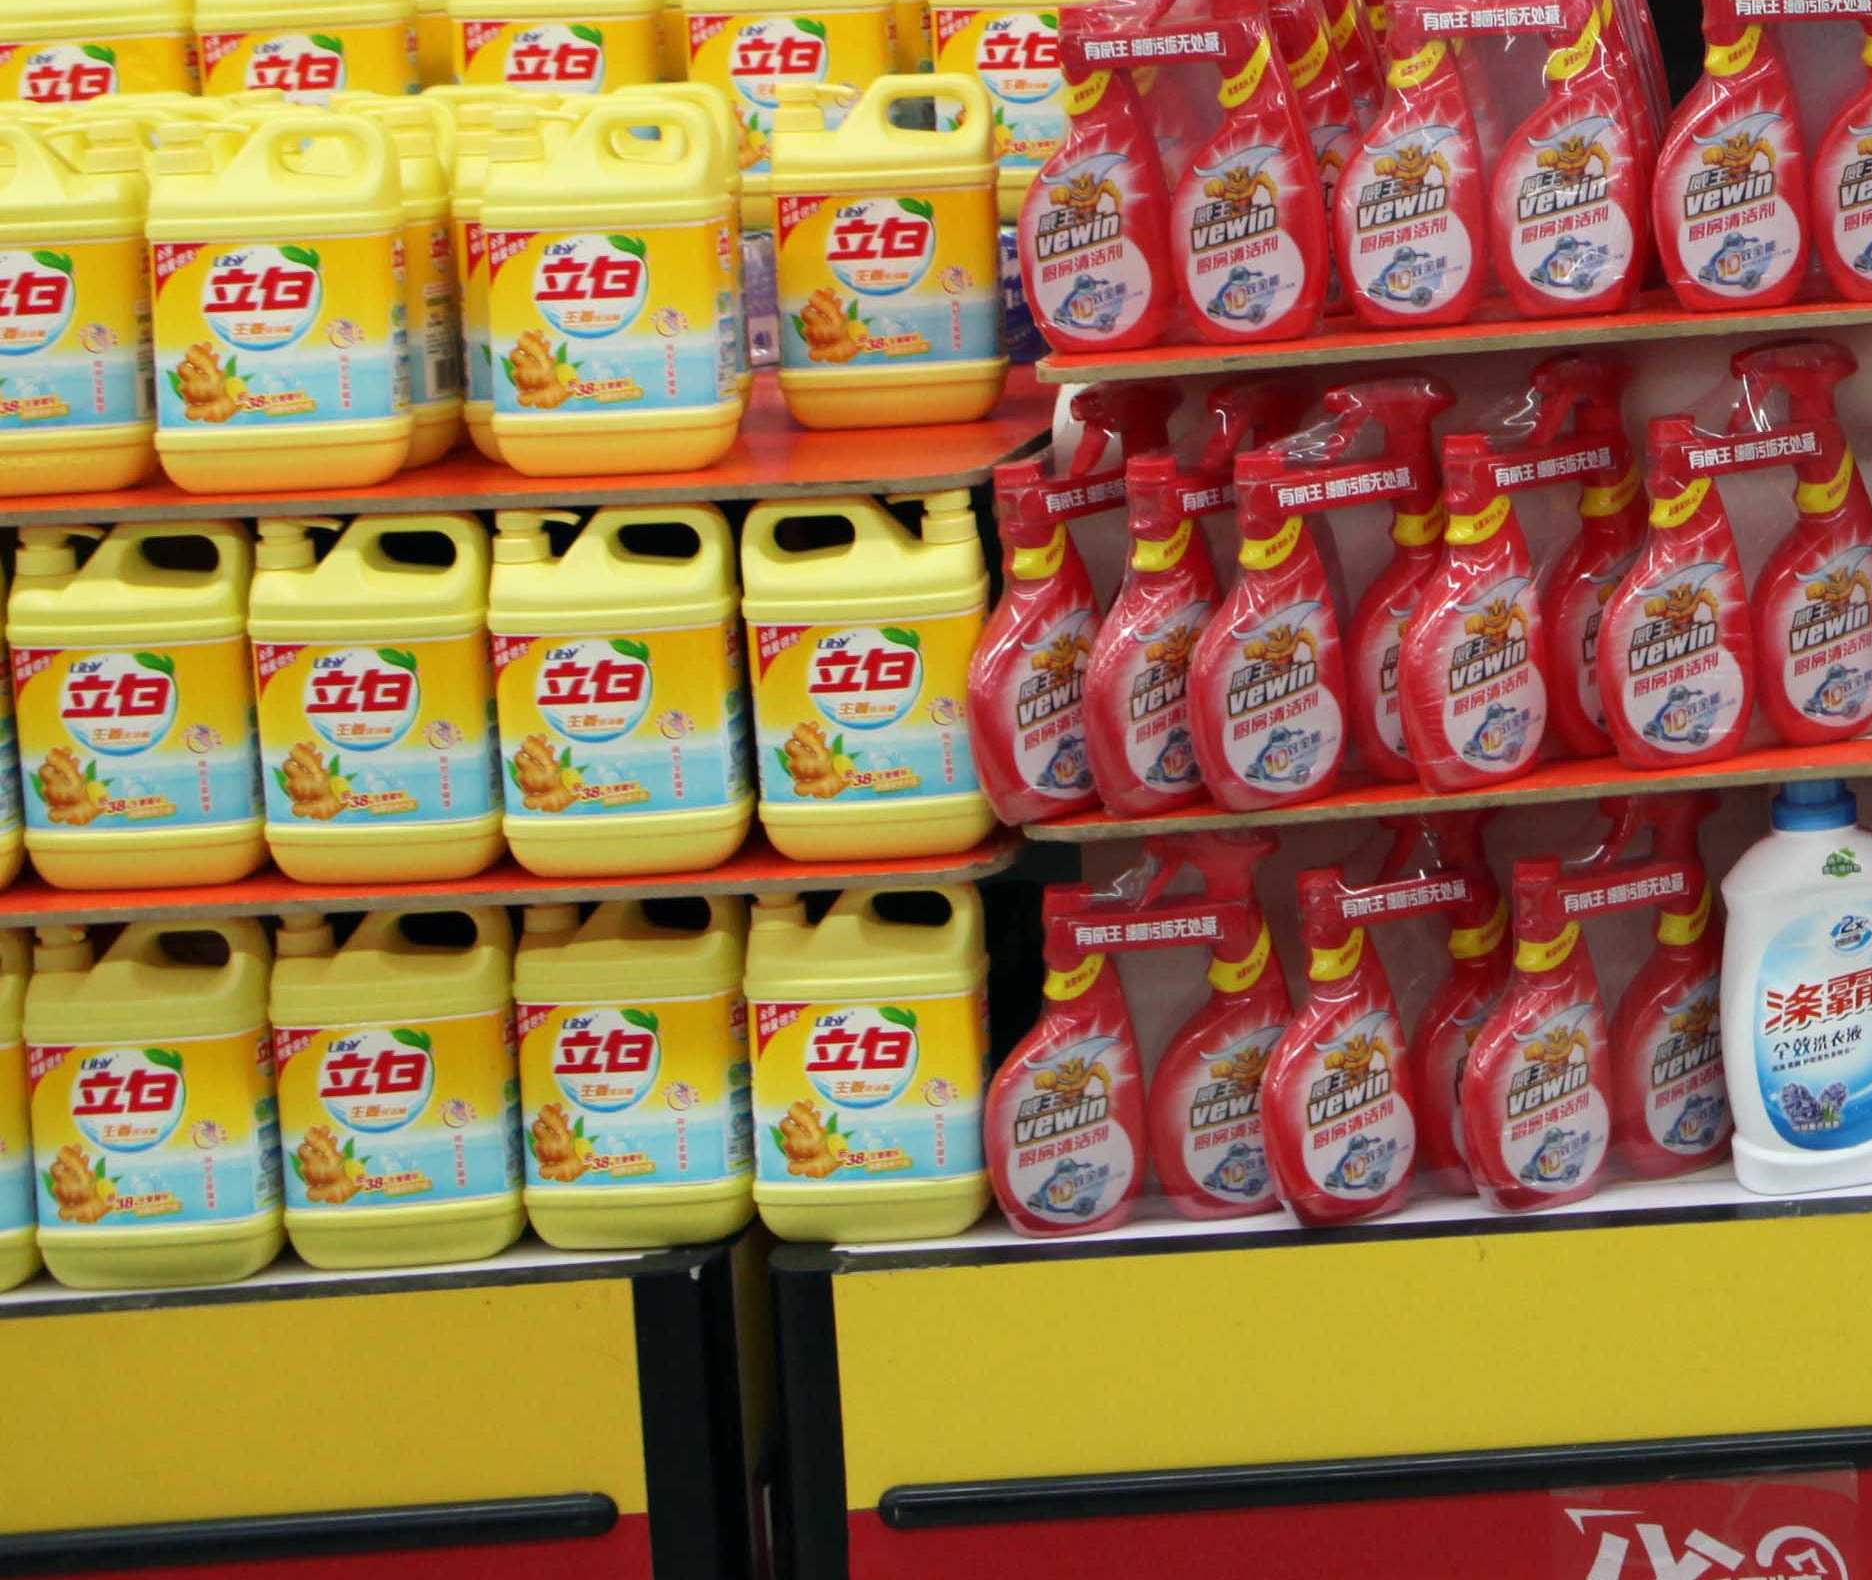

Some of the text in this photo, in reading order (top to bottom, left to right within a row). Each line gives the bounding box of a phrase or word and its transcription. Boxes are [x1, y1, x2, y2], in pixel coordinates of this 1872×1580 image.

[1357, 184, 1446, 230] vewin
[1684, 171, 1775, 219] vewin
[828, 217, 929, 261] 立白
[1191, 206, 1278, 252] vewin
[1359, 214, 1449, 255] 厨房清洁剂
[1520, 206, 1610, 245] 厨房清洁剂
[1688, 201, 1777, 243] 厨房清洁剂
[536, 256, 641, 301] 立白
[1196, 235, 1280, 276] 厨房清洁剂
[205, 267, 314, 313] 立白
[1629, 621, 1717, 675] vewin
[1789, 601, 1870, 655] vewin
[307, 669, 412, 713] 立白
[538, 660, 644, 705] 立白
[810, 648, 915, 693] 立白
[1226, 659, 1316, 719] vewin
[1633, 650, 1719, 699] 厨房清洁剂
[62, 673, 170, 718] 立白
[555, 1029, 653, 1074] 立白
[807, 1027, 911, 1072] 立白
[73, 1069, 178, 1116] 立白
[320, 1050, 427, 1097] 立白
[1507, 1063, 1588, 1118] vewin
[1014, 1093, 1108, 1143] vewin
[1018, 1123, 1111, 1170] 厨房清洁剂
